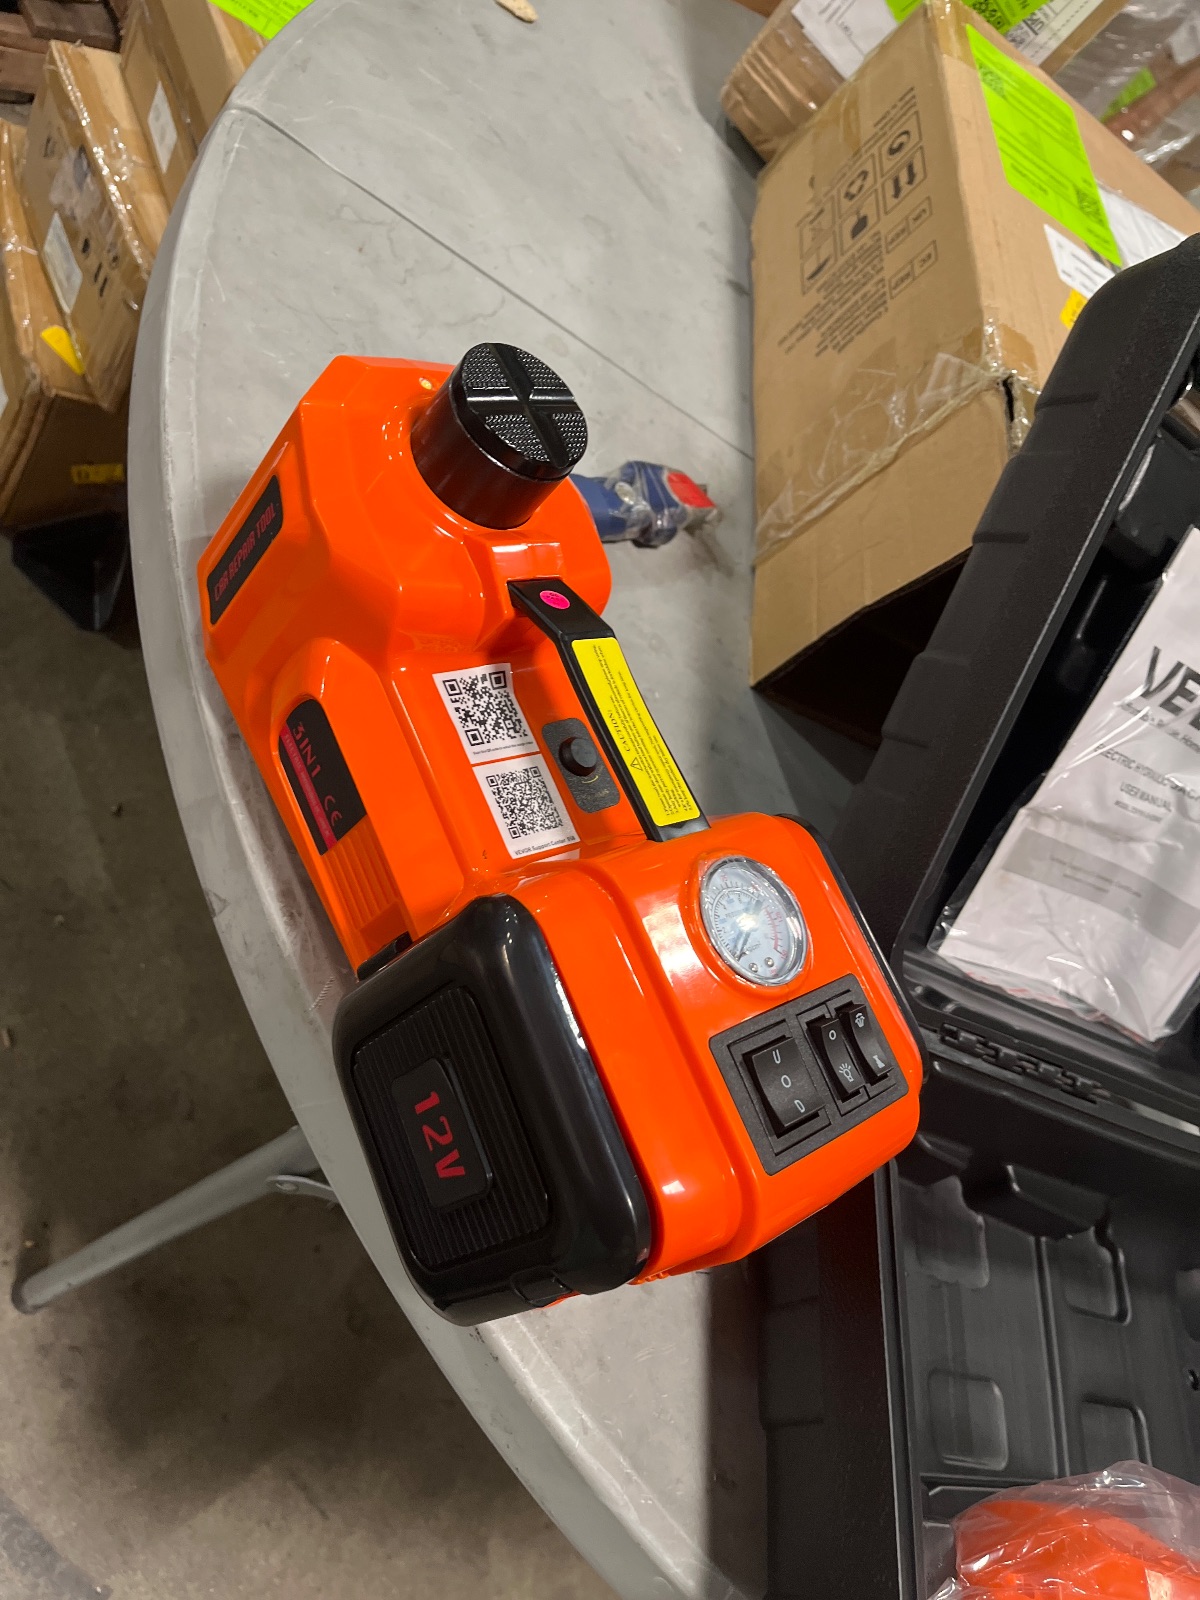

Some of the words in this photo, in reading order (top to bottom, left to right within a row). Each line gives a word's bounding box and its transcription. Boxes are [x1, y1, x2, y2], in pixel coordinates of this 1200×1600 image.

[214, 571, 229, 601] CAR
[228, 530, 256, 580] REPAIR
[256, 502, 276, 538] TOOL
[514, 847, 533, 856] VEVOR
[531, 841, 550, 852] Support
[772, 1049, 781, 1064] U
[794, 1099, 806, 1113] D
[414, 1091, 466, 1178] 12V
